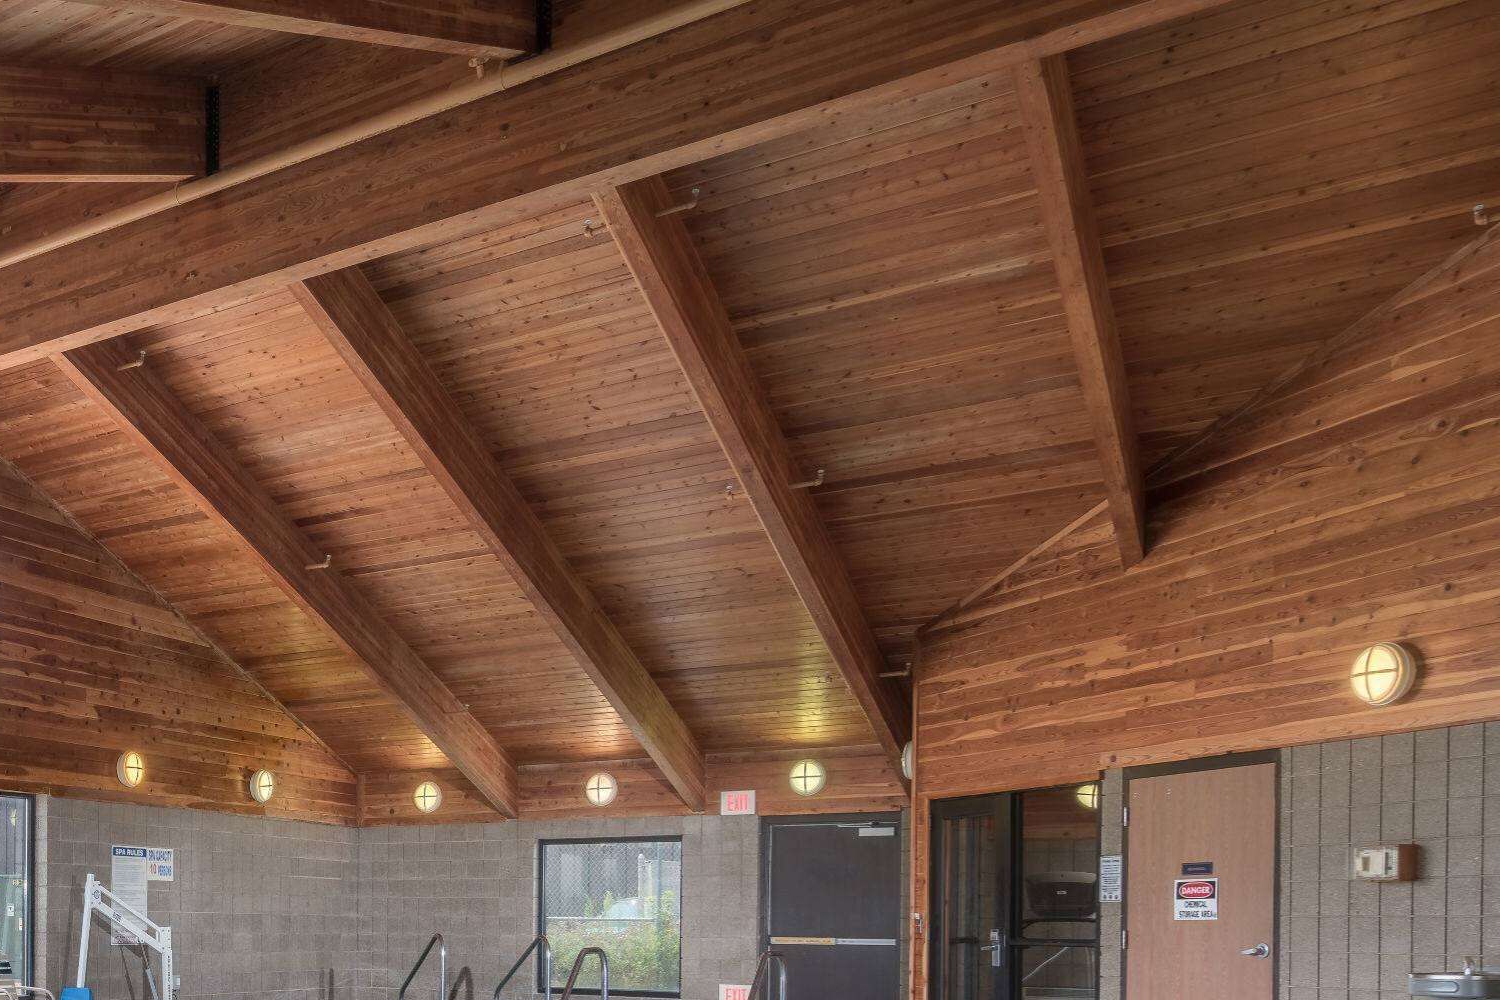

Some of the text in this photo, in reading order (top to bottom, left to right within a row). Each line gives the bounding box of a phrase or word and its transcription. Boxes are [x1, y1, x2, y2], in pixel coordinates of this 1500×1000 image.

[727, 793, 748, 811] EXIT
[127, 849, 144, 857] RULES
[1181, 886, 1210, 895] DANGER
